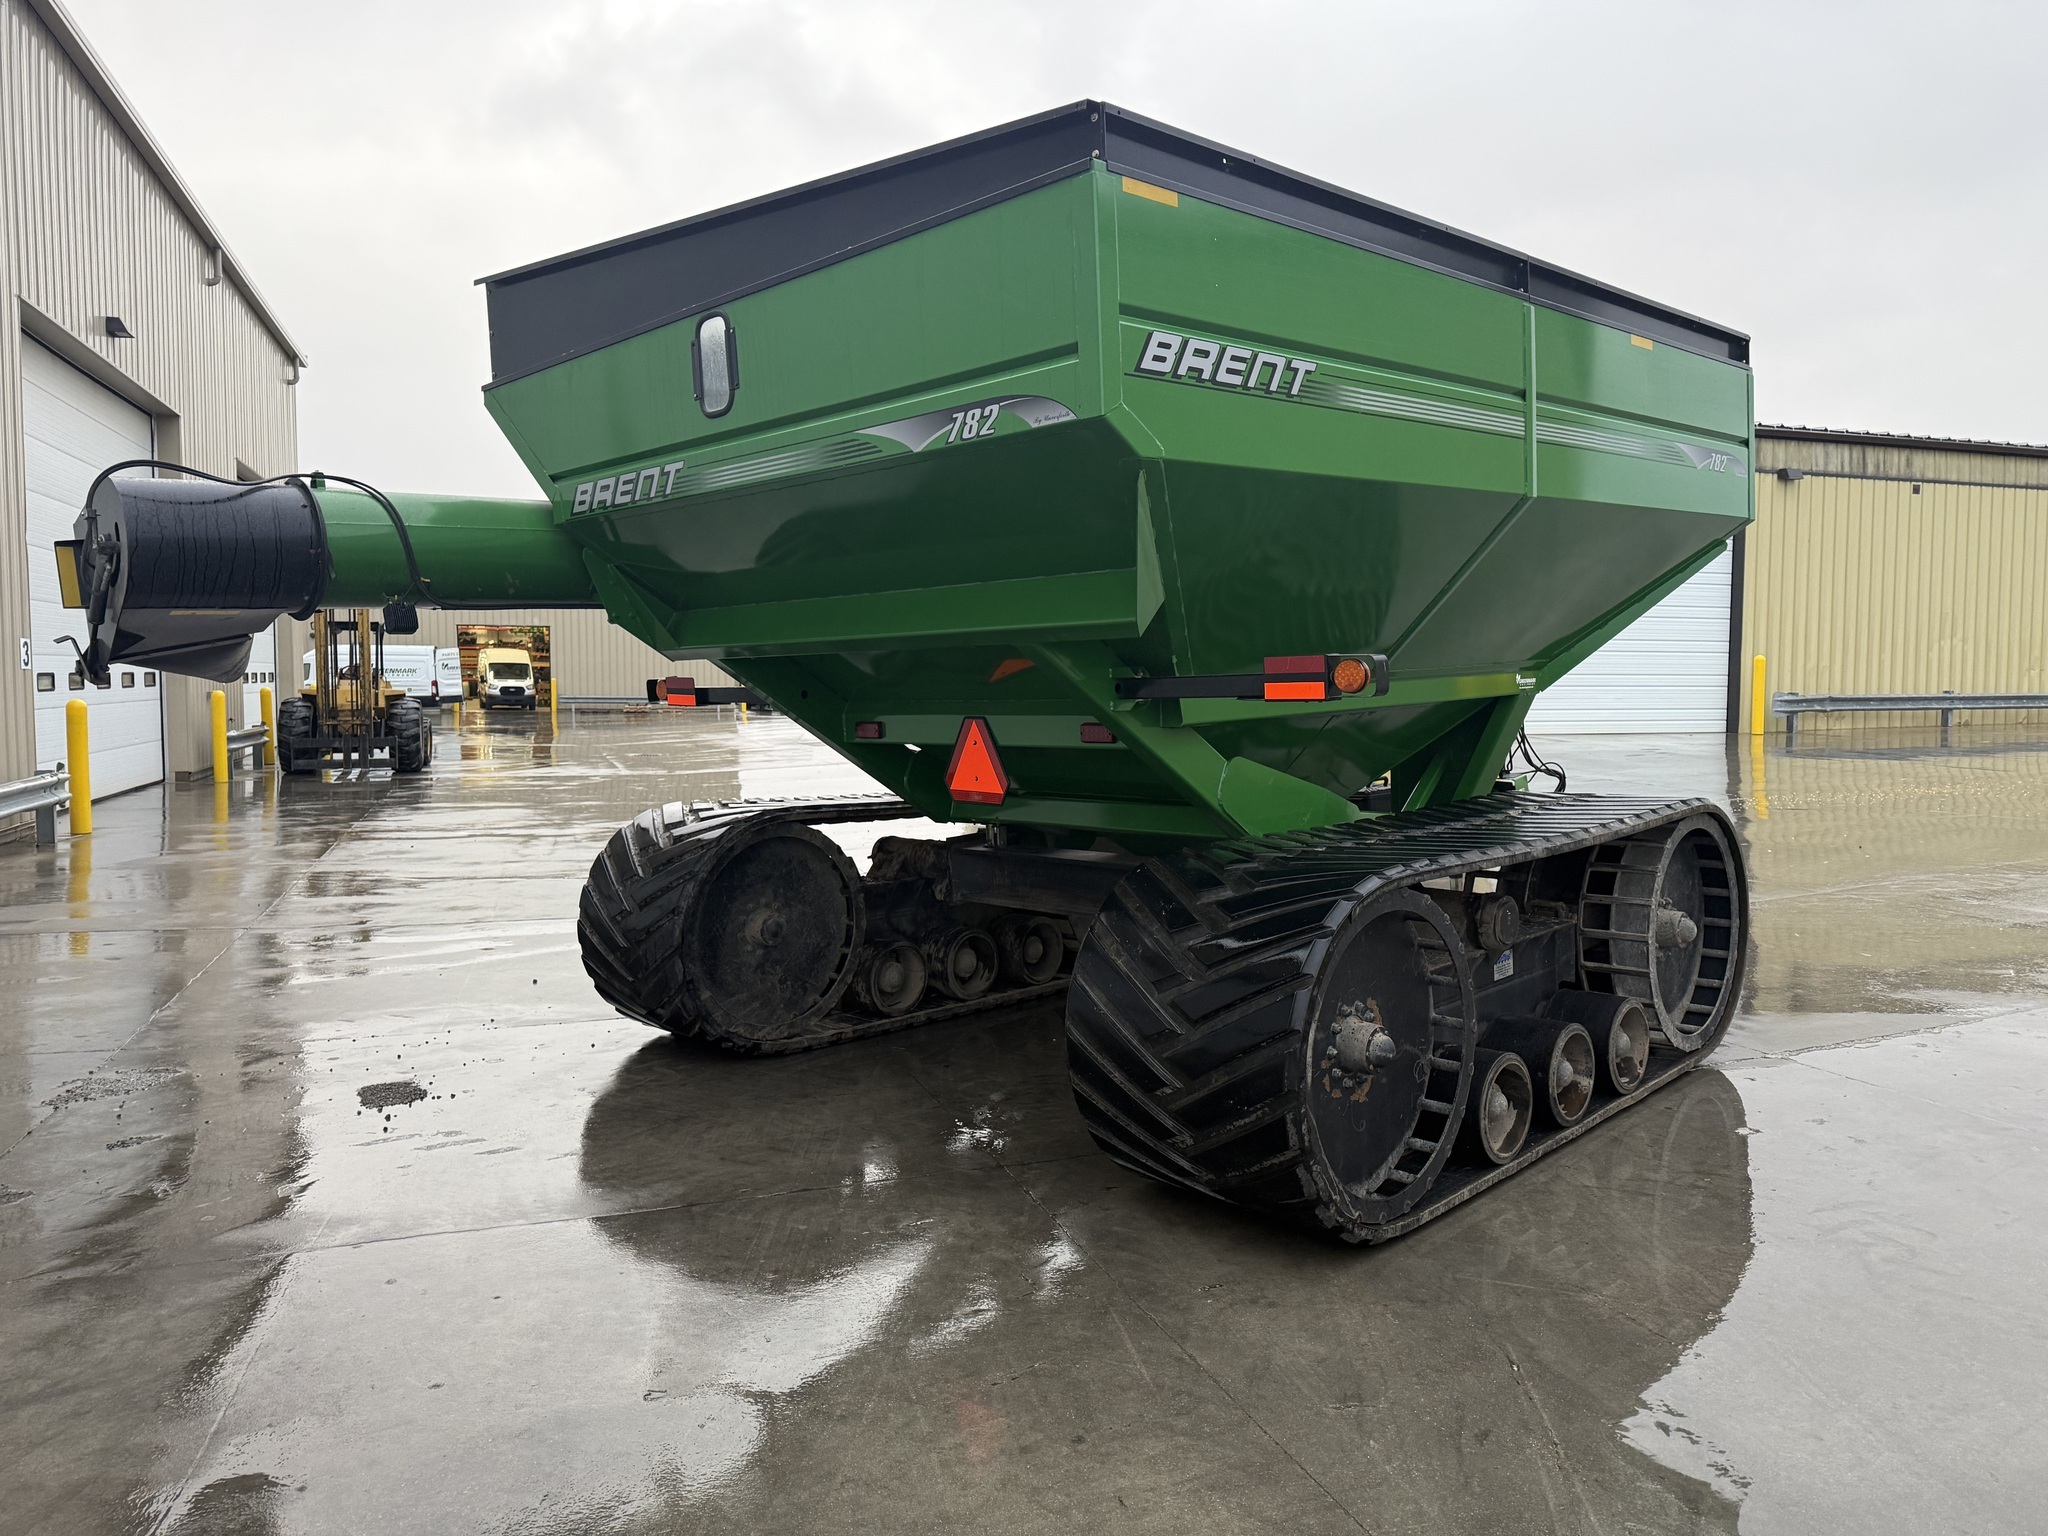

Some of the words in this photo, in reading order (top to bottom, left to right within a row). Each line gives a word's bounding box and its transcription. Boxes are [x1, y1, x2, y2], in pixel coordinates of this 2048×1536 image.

[1135, 330, 1317, 397] BRENT
[946, 403, 1000, 444] 782
[1709, 453, 1727, 472] 782
[571, 460, 685, 515] BRENT
[22, 641, 30, 667] 3
